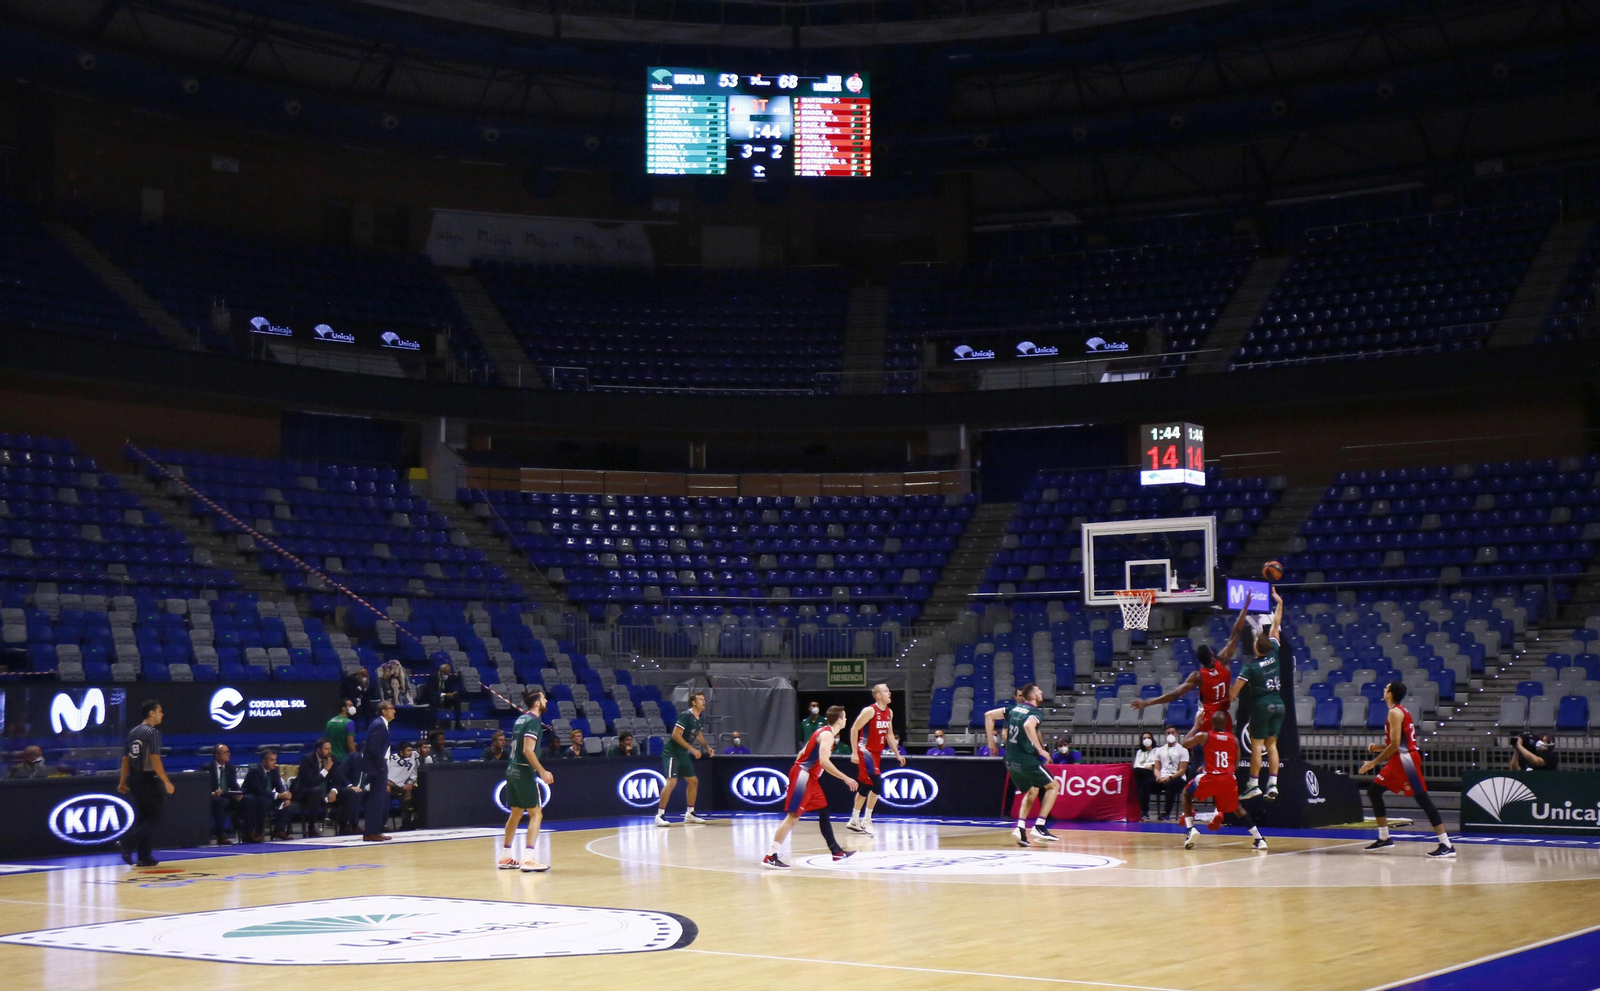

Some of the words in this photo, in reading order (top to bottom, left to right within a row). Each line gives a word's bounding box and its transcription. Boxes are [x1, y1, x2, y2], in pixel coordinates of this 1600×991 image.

[674, 74, 705, 85] UNICAJA
[719, 73, 739, 88] 53
[779, 75, 798, 89] 68
[746, 124, 781, 139] 1:44
[741, 144, 753, 158] 3
[771, 145, 783, 158] 2
[268, 325, 292, 334] Unicaja
[332, 332, 355, 342] Unicaja
[398, 340, 420, 349] Unicaja
[1035, 346, 1058, 354] Unicaja
[1104, 341, 1128, 349] Unicaja
[971, 350, 995, 358] Unicaja
[1151, 426, 1181, 440] 1:44
[1188, 427, 1203, 442] 1:44
[1147, 445, 1179, 470] 14
[1186, 445, 1203, 471] 14
[1247, 592, 1268, 600] ovistar
[832, 665, 851, 673] SALIDA
[854, 665, 862, 673] DE
[1213, 682, 1226, 700] 77
[249, 700, 274, 708] COSTA
[276, 700, 290, 708] DEL
[249, 708, 282, 717] MÁLAGA
[1215, 750, 1229, 768] 18
[628, 778, 660, 799] KIA
[742, 777, 782, 797] KIA
[884, 778, 927, 799] KIA
[1015, 770, 1122, 796] desa
[64, 805, 121, 834] KIA
[336, 918, 559, 949] Unicaja
